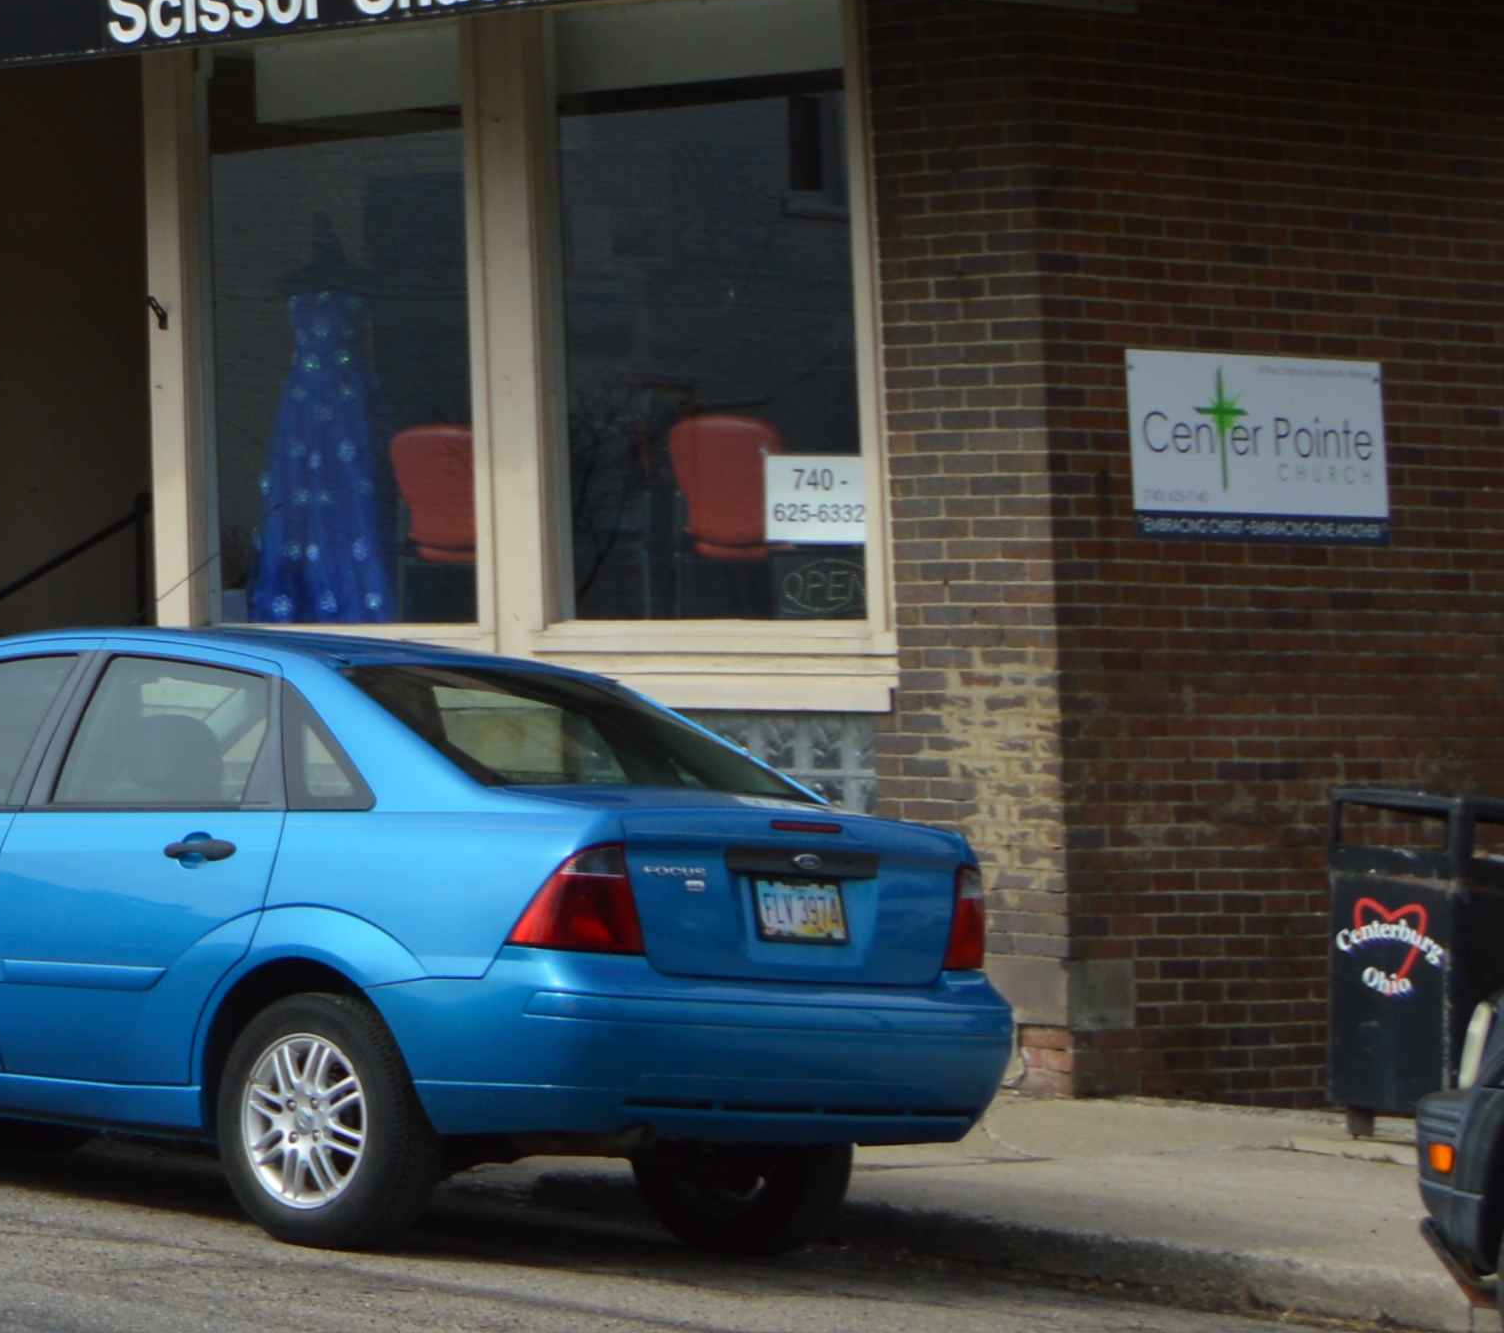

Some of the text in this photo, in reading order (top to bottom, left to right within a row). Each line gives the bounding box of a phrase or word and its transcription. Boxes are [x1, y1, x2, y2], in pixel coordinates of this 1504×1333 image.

[1274, 417, 1373, 461] Pointe
[792, 468, 834, 491] 740
[1276, 464, 1374, 484] CHURCH
[773, 503, 866, 523] 625-6332
[643, 865, 706, 878] FOCUS
[1335, 918, 1444, 965] Centerburg
[1362, 966, 1412, 995] Ohio
